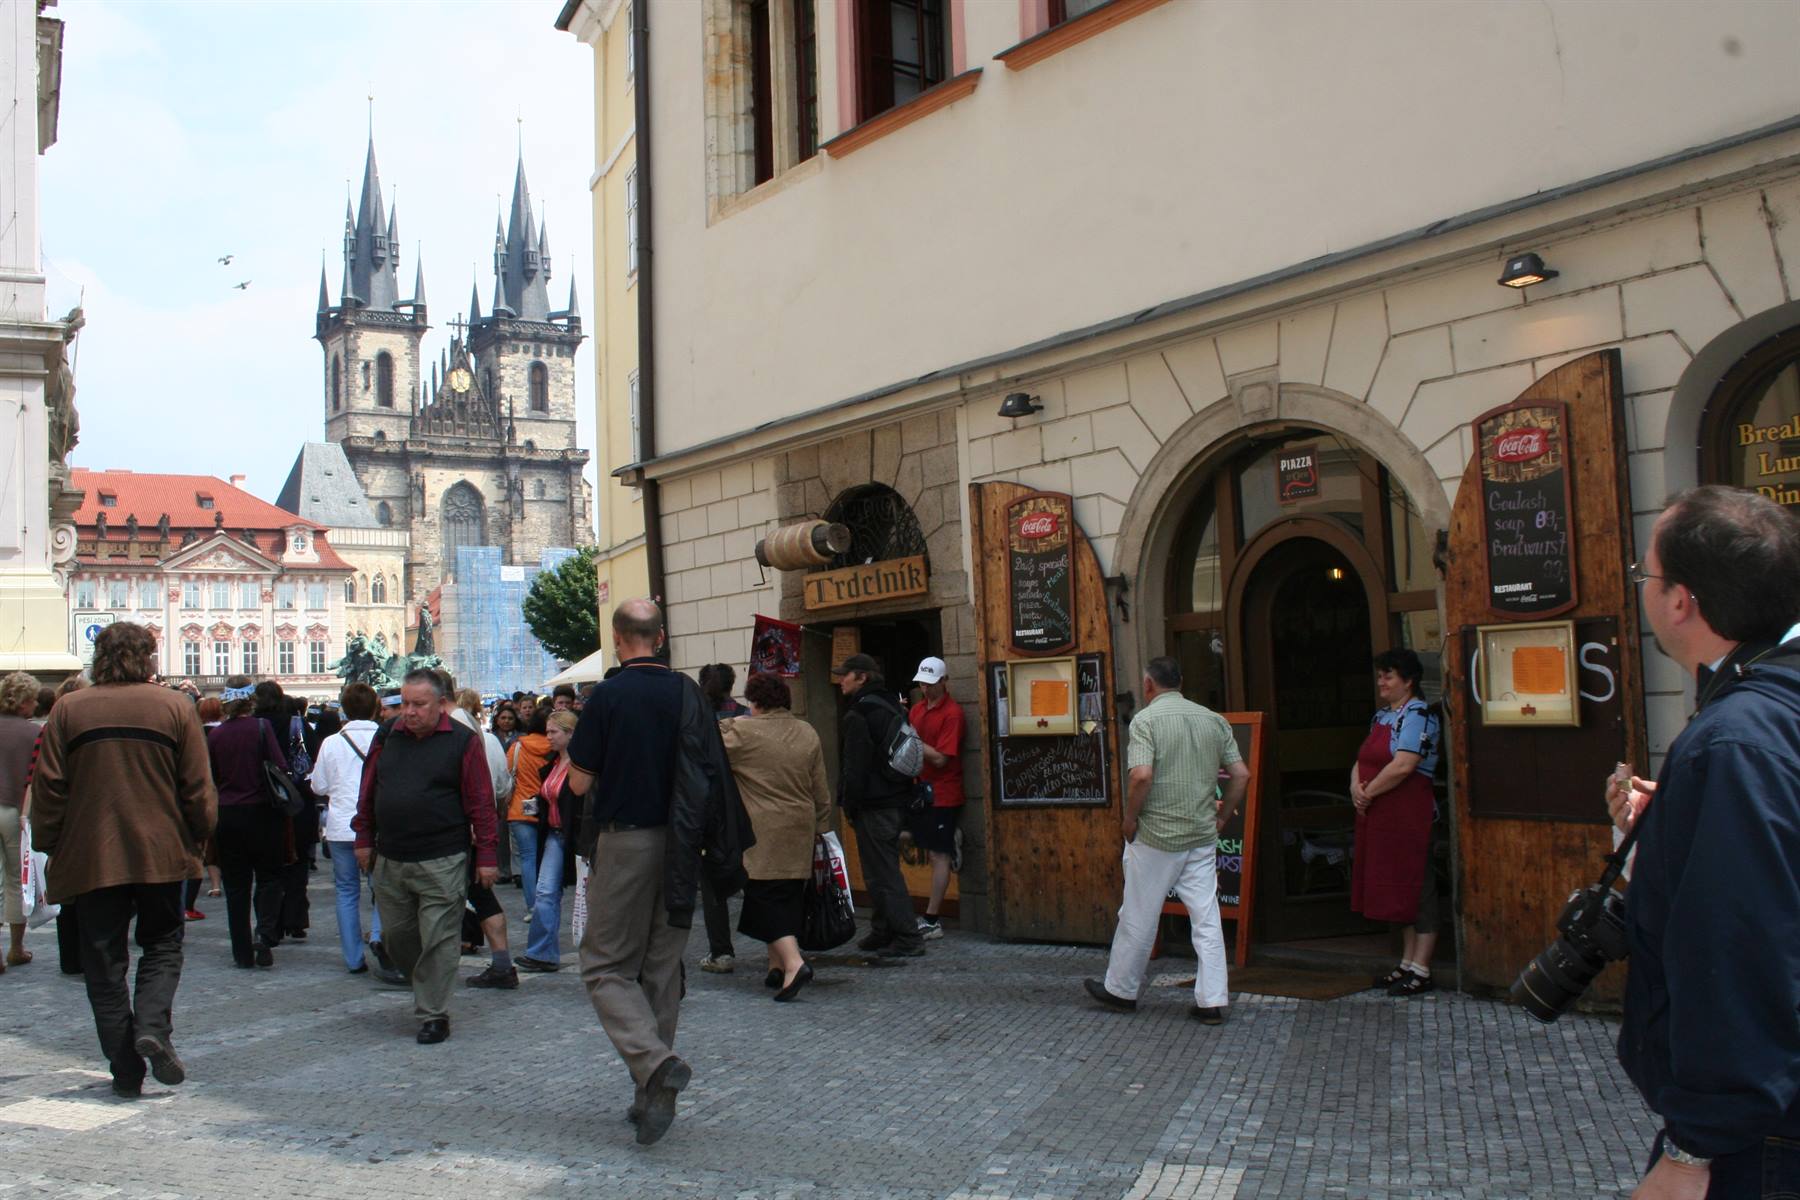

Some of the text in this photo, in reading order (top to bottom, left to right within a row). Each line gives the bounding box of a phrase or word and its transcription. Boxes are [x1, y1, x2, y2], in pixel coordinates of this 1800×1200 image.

[1280, 455, 1313, 472] PIAZZA
[1488, 490, 1547, 511] Goulash
[1494, 517, 1526, 540] soup
[1491, 531, 1567, 556] Bratwurst
[1494, 582, 1533, 594] RESTAURANT
[1015, 628, 1044, 637] RESTAURANT
[1220, 894, 1240, 905] WINE
